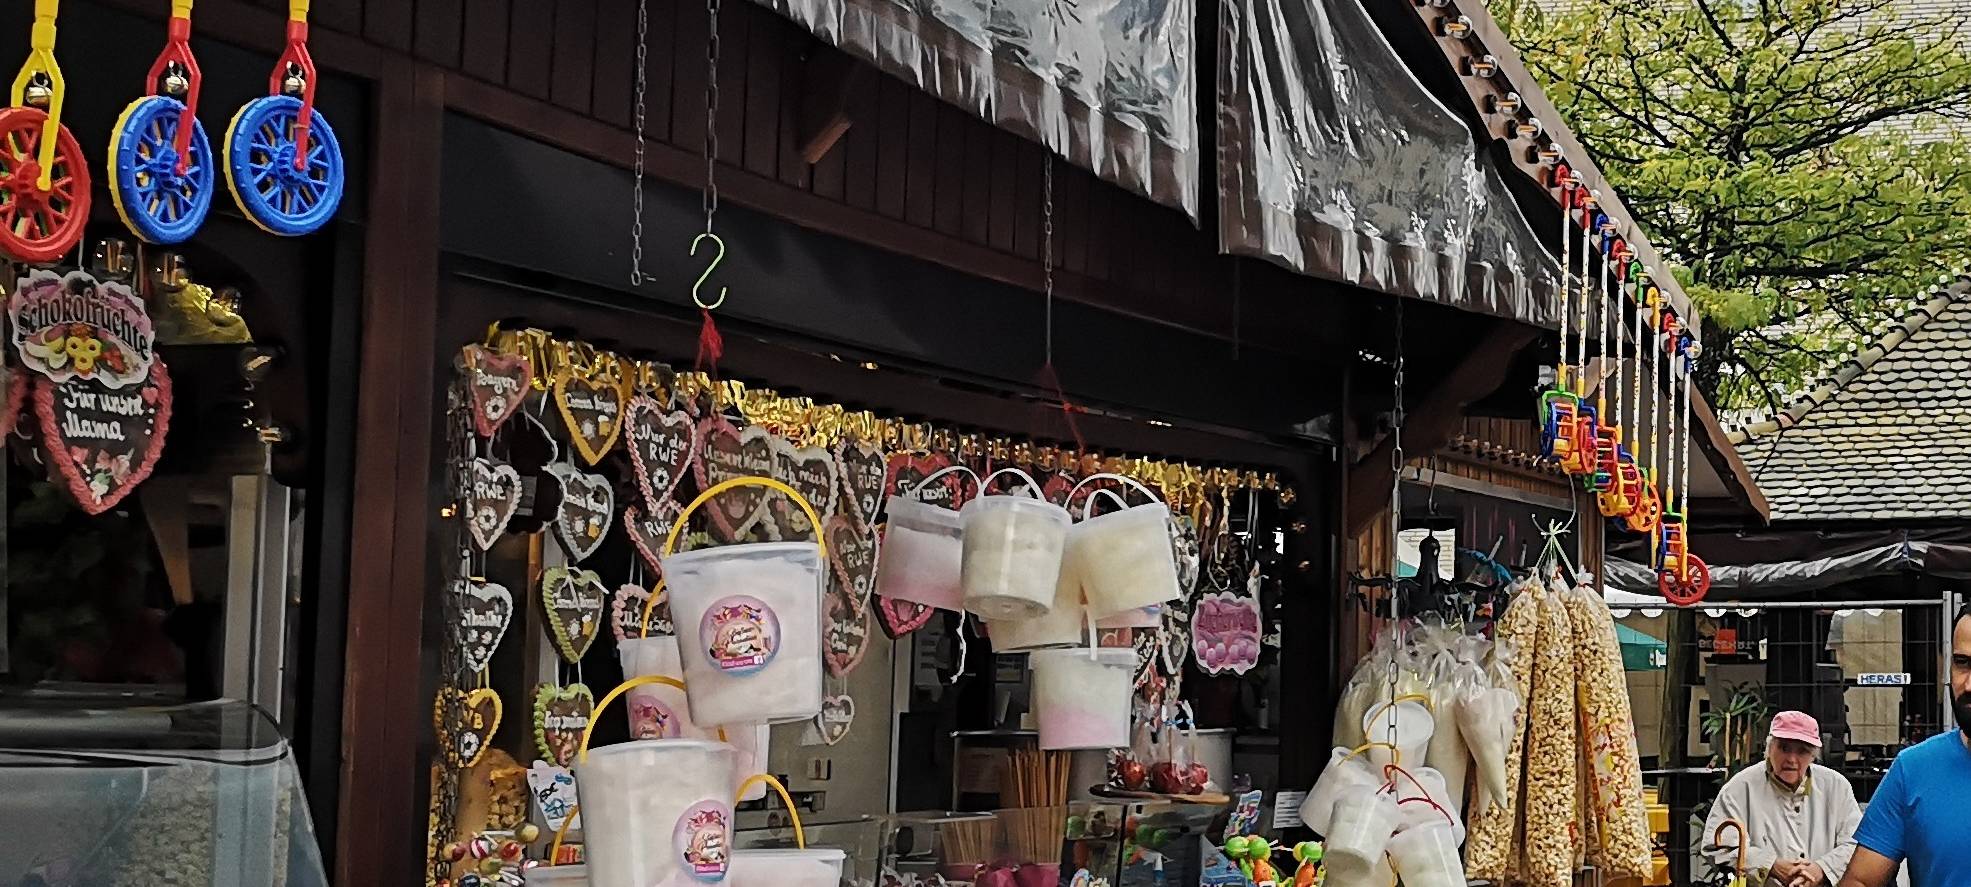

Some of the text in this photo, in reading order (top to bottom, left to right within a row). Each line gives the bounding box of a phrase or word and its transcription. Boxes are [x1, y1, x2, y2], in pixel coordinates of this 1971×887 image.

[60, 380, 97, 410] Für
[61, 410, 126, 442] Mama
[635, 424, 667, 446] Nur
[649, 442, 679, 466] RWE
[474, 480, 506, 500] RWE
[644, 520, 674, 539] RWE
[1860, 674, 1902, 684] HERAS
